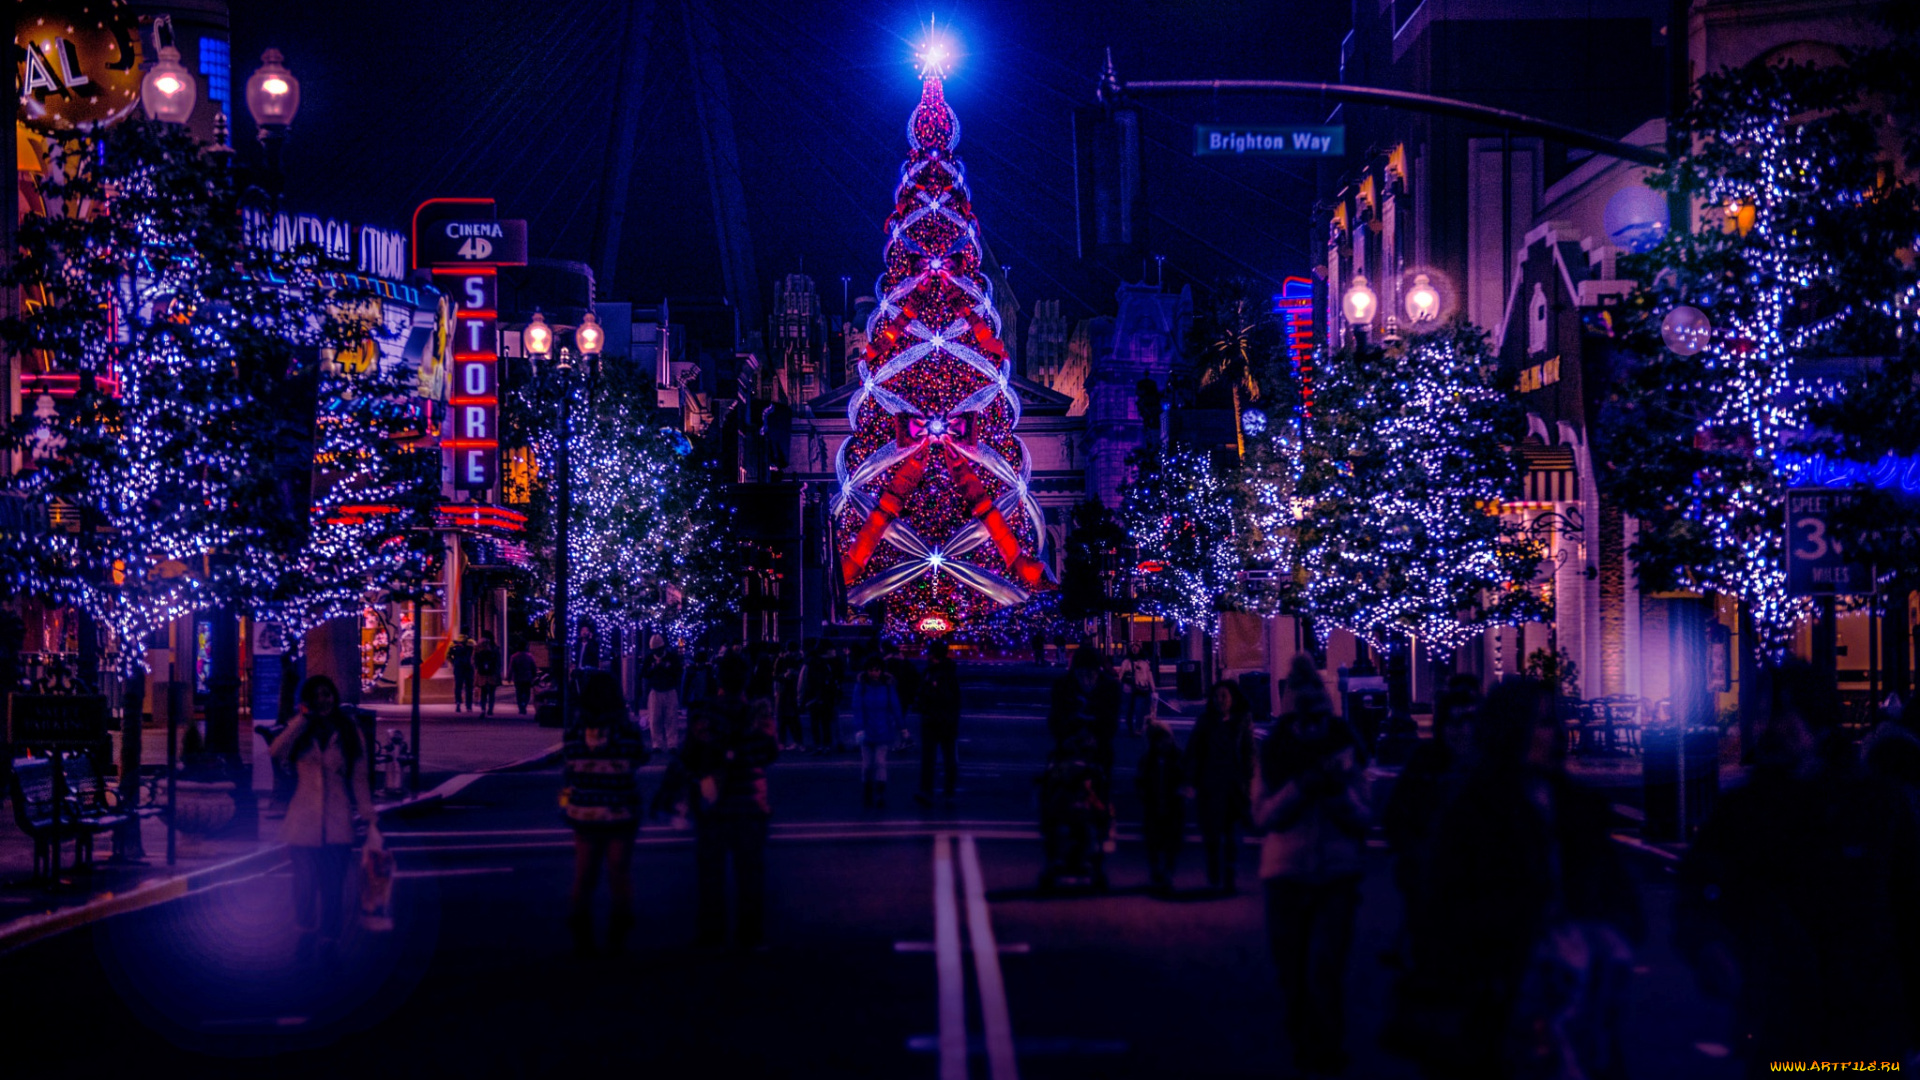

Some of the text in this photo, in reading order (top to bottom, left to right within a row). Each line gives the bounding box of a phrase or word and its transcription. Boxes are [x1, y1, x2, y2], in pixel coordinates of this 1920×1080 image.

[1209, 131, 1331, 153] Brighton Way
[464, 276, 487, 484] STORE
[1812, 566, 1850, 583] MILES
